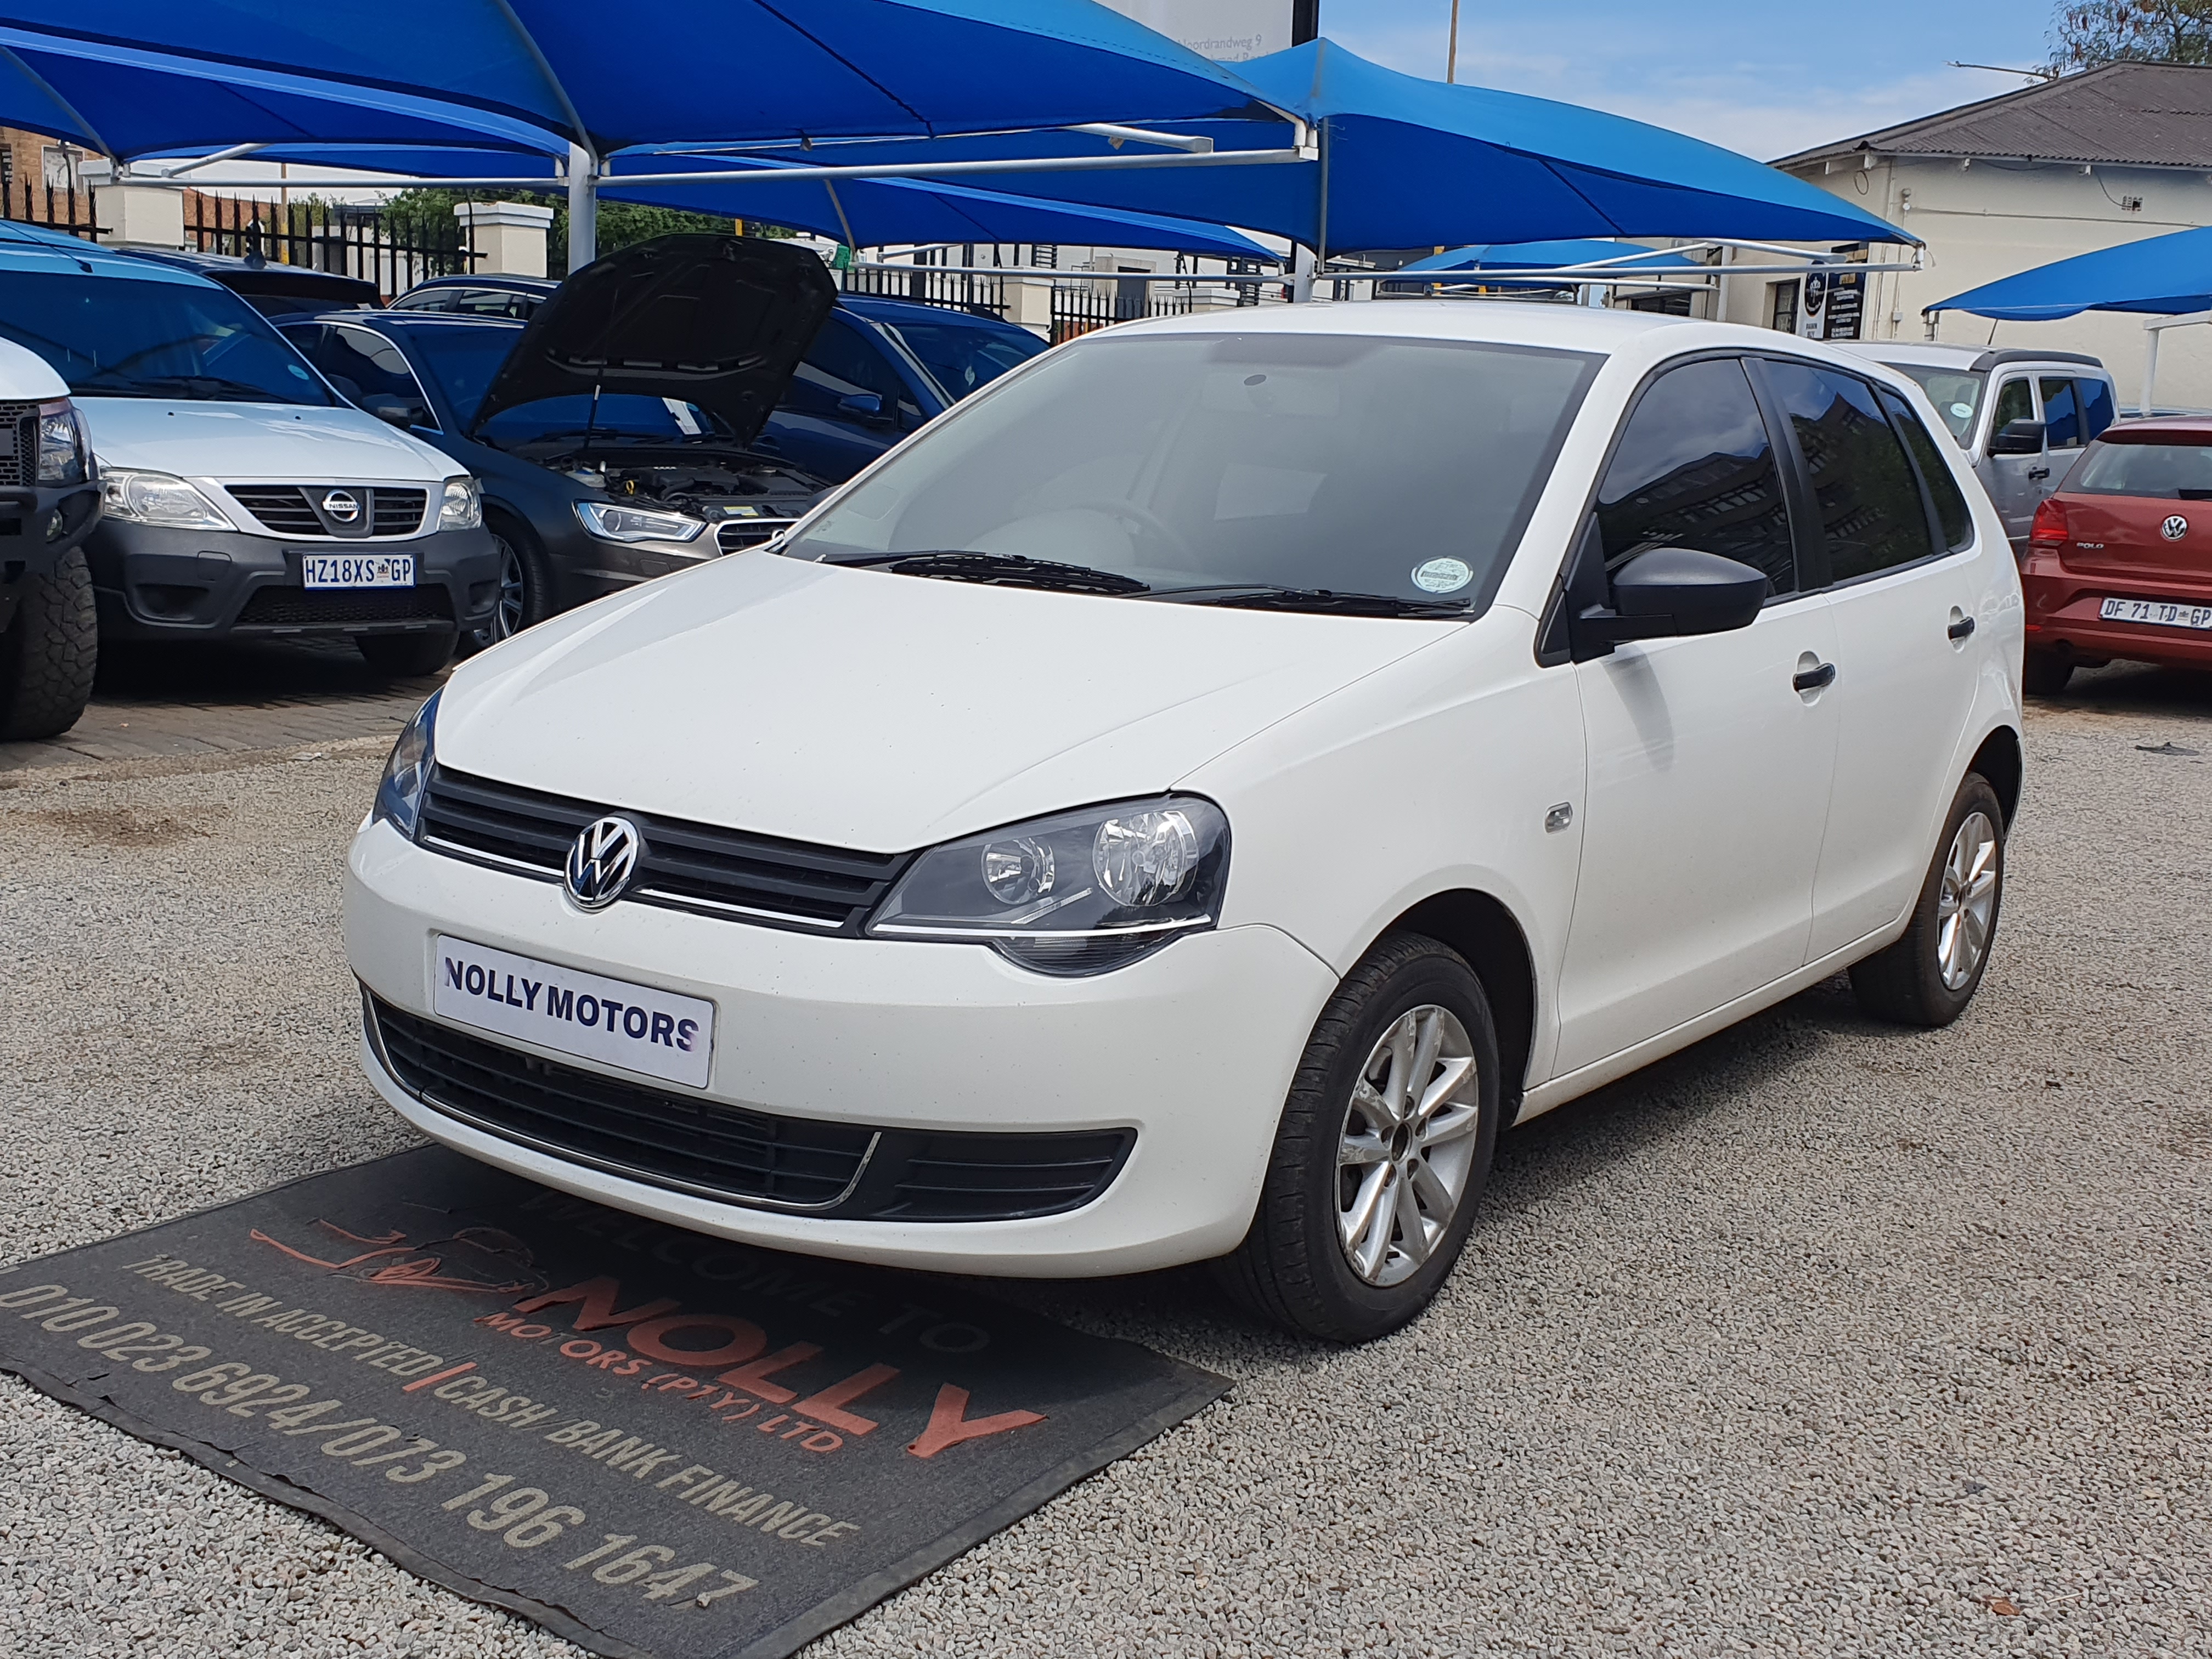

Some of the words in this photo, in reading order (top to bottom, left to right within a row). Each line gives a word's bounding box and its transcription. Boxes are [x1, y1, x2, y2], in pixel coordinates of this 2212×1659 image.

[1255, 34, 1262, 46] 9
[391, 558, 411, 582] GP
[2104, 600, 2126, 616] DF
[2131, 603, 2149, 619] 71
[2159, 605, 2178, 622] TD
[2191, 607, 2211, 625] GP
[444, 957, 543, 1011] NOLLY
[546, 985, 699, 1052] MOTORS
[512, 1275, 1048, 1459] NOLLY
[878, 1302, 990, 1353] TO
[122, 1254, 246, 1302] TRADE
[216, 1291, 284, 1318] IN
[251, 1310, 445, 1376] ACCEPTED
[655, 1463, 861, 1547] FINANCE
[473, 1311, 653, 1375] MOTORS
[641, 1373, 761, 1421] (PTY)
[757, 1414, 844, 1452] LTD
[0, 1284, 120, 1332] 010
[77, 1322, 212, 1372] 023
[441, 1472, 586, 1549] 196
[563, 1533, 760, 1609] 1647
